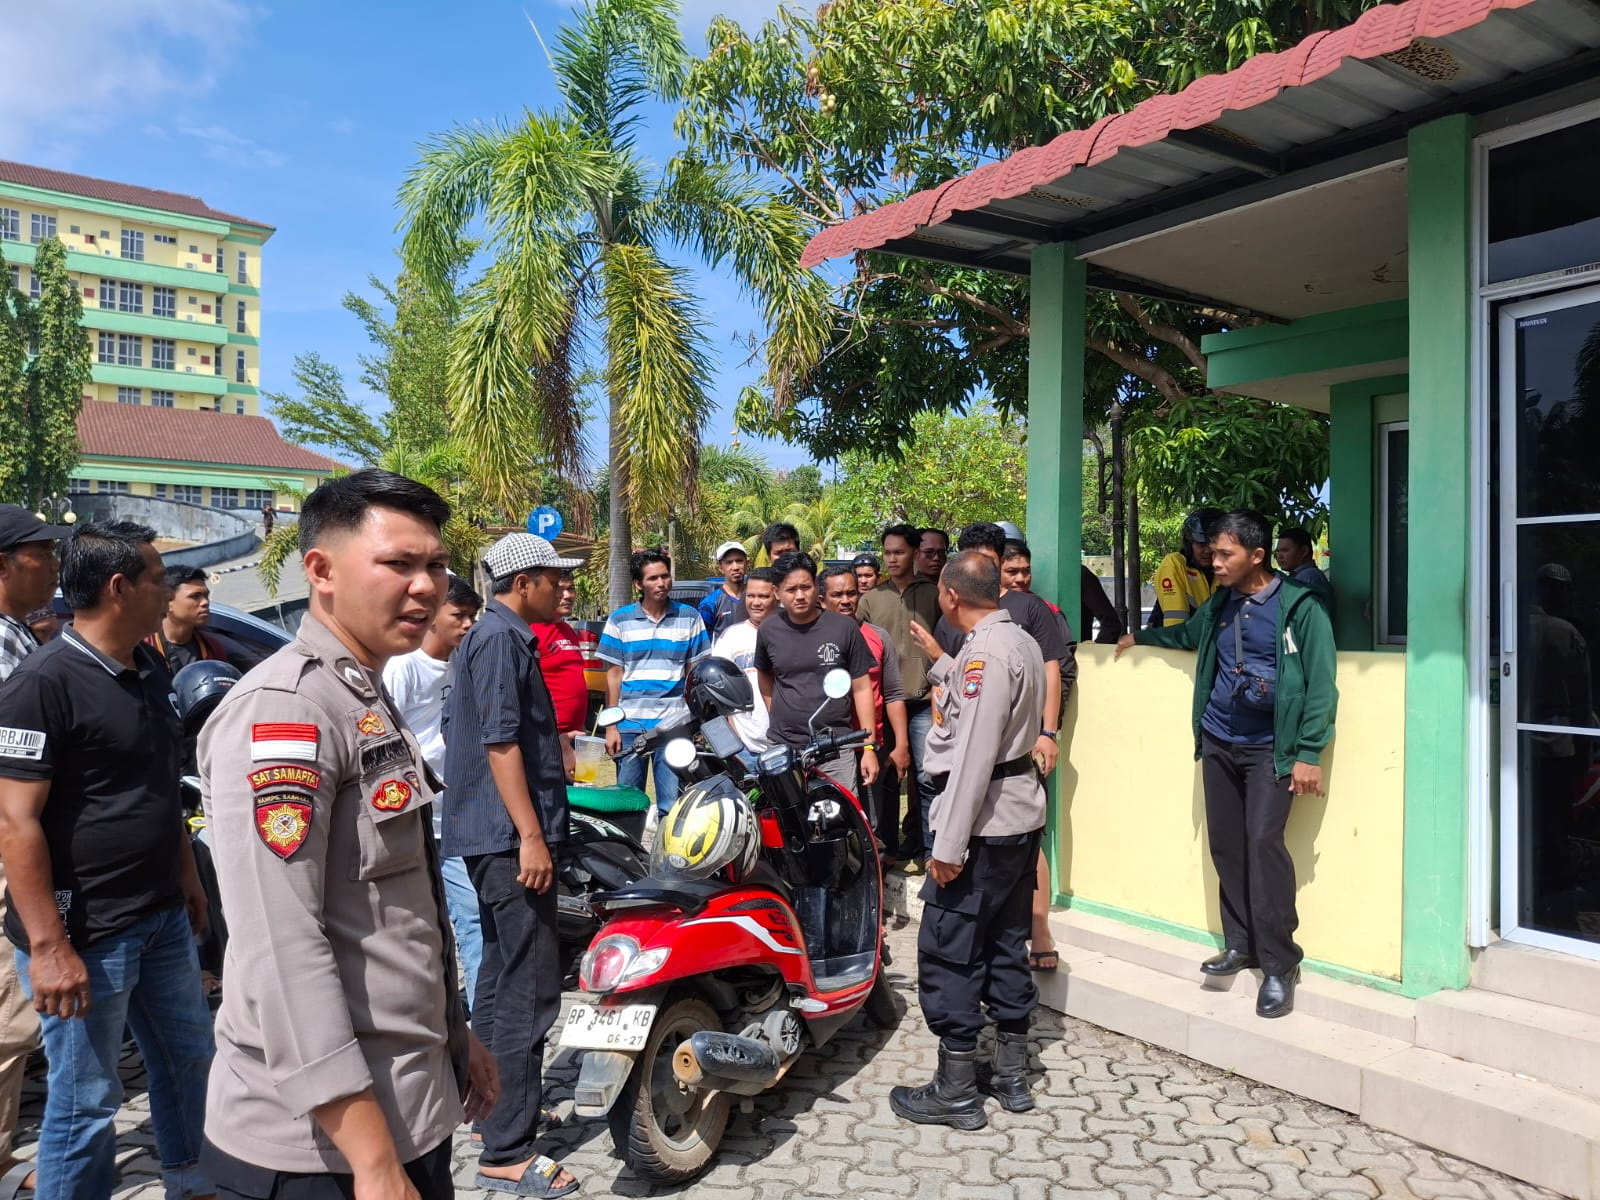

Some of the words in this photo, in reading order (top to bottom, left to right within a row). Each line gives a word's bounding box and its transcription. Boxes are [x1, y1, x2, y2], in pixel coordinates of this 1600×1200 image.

[539, 513, 555, 534] P
[252, 770, 271, 785] SAT
[273, 767, 316, 784] SAMAPTA
[567, 1008, 586, 1025] BP
[590, 1009, 622, 1026] 3461
[632, 1010, 652, 1027] KB
